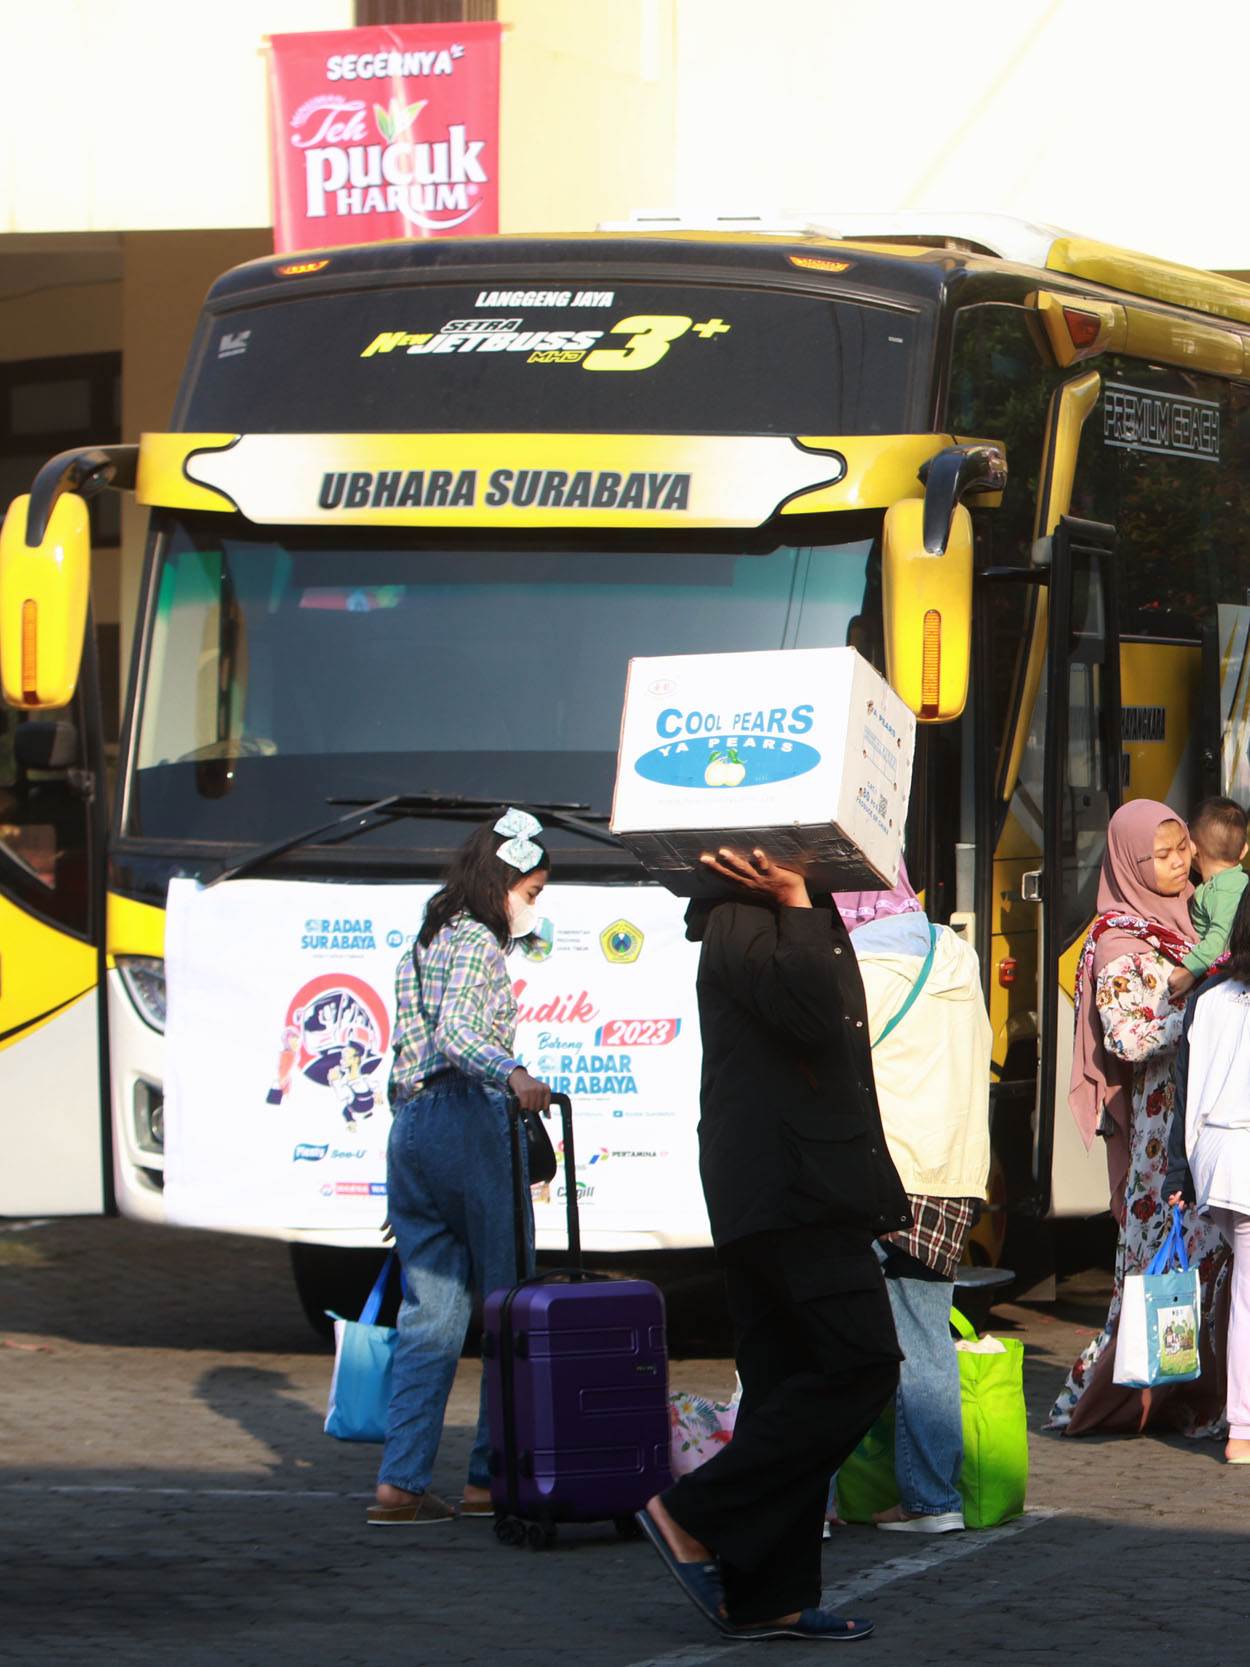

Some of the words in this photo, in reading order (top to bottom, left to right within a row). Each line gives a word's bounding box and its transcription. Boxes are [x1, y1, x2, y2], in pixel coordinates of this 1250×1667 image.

[326, 50, 453, 81] SEGERNYA
[304, 124, 488, 217] pucuk
[336, 183, 469, 216] HARUM
[475, 291, 569, 307] LANGGENG
[571, 292, 615, 307] JAYA
[440, 318, 524, 333] SETRA
[318, 469, 476, 510] UBHARA
[485, 469, 693, 511] SURABAYA
[733, 704, 815, 734] PEARS
[658, 742, 689, 757] YA
[708, 737, 793, 753] PEARS
[321, 919, 373, 933] RADAR
[301, 935, 376, 949] SURABAYA
[513, 979, 600, 1024] udik
[607, 1020, 671, 1045] 2023
[560, 1055, 631, 1073] RADAR
